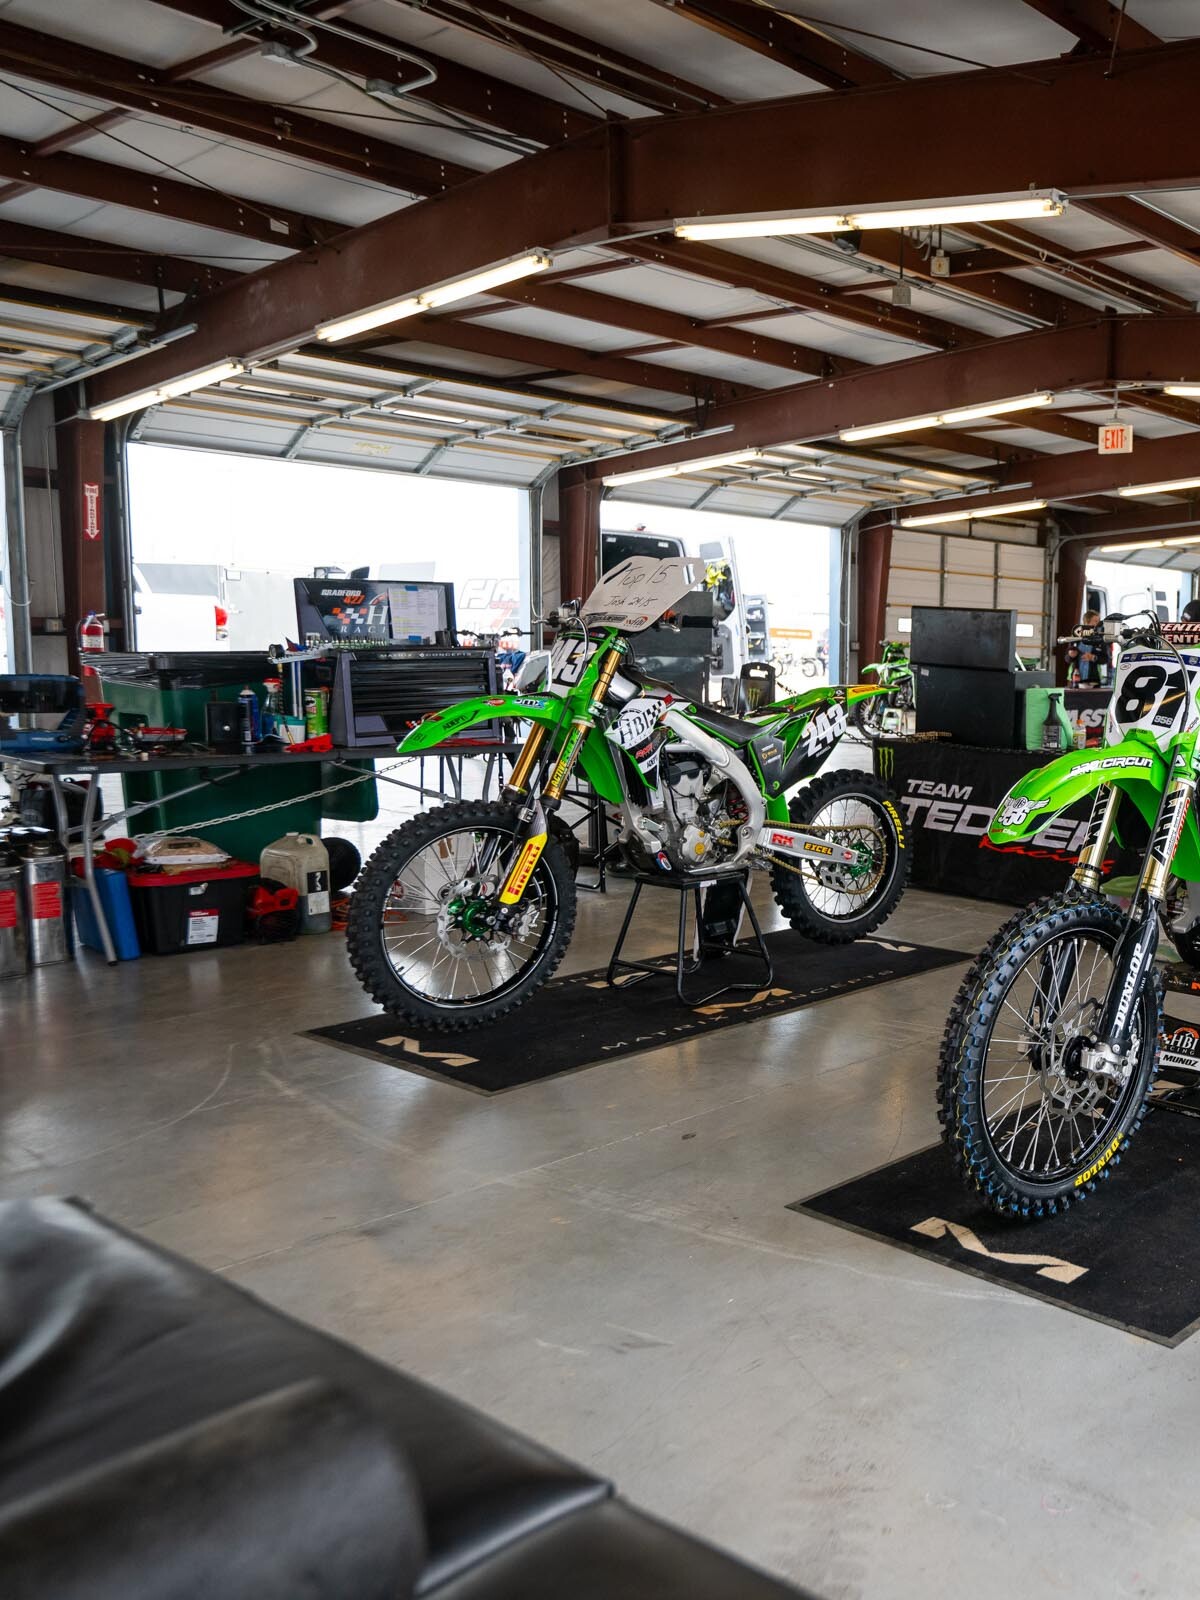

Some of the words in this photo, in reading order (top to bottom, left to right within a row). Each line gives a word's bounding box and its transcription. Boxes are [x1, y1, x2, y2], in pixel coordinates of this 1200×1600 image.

[1104, 428, 1125, 450] EXIT
[617, 565, 646, 589] Top
[321, 589, 362, 597] BRADFORD
[343, 595, 367, 605] 427
[1115, 665, 1197, 724] 81
[801, 703, 848, 757] 243
[1154, 716, 1174, 726] 956
[907, 779, 973, 800] TEAM
[883, 800, 906, 849] PIRELLI
[772, 833, 795, 848] RK
[804, 842, 834, 855] EXCEL
[507, 843, 540, 896] PIRELLI
[1115, 942, 1144, 1031] DUNLOP
[1170, 1034, 1199, 1050] HBI
[1162, 1055, 1198, 1068] MUNOZ
[1074, 1138, 1121, 1187] DUNLOP
